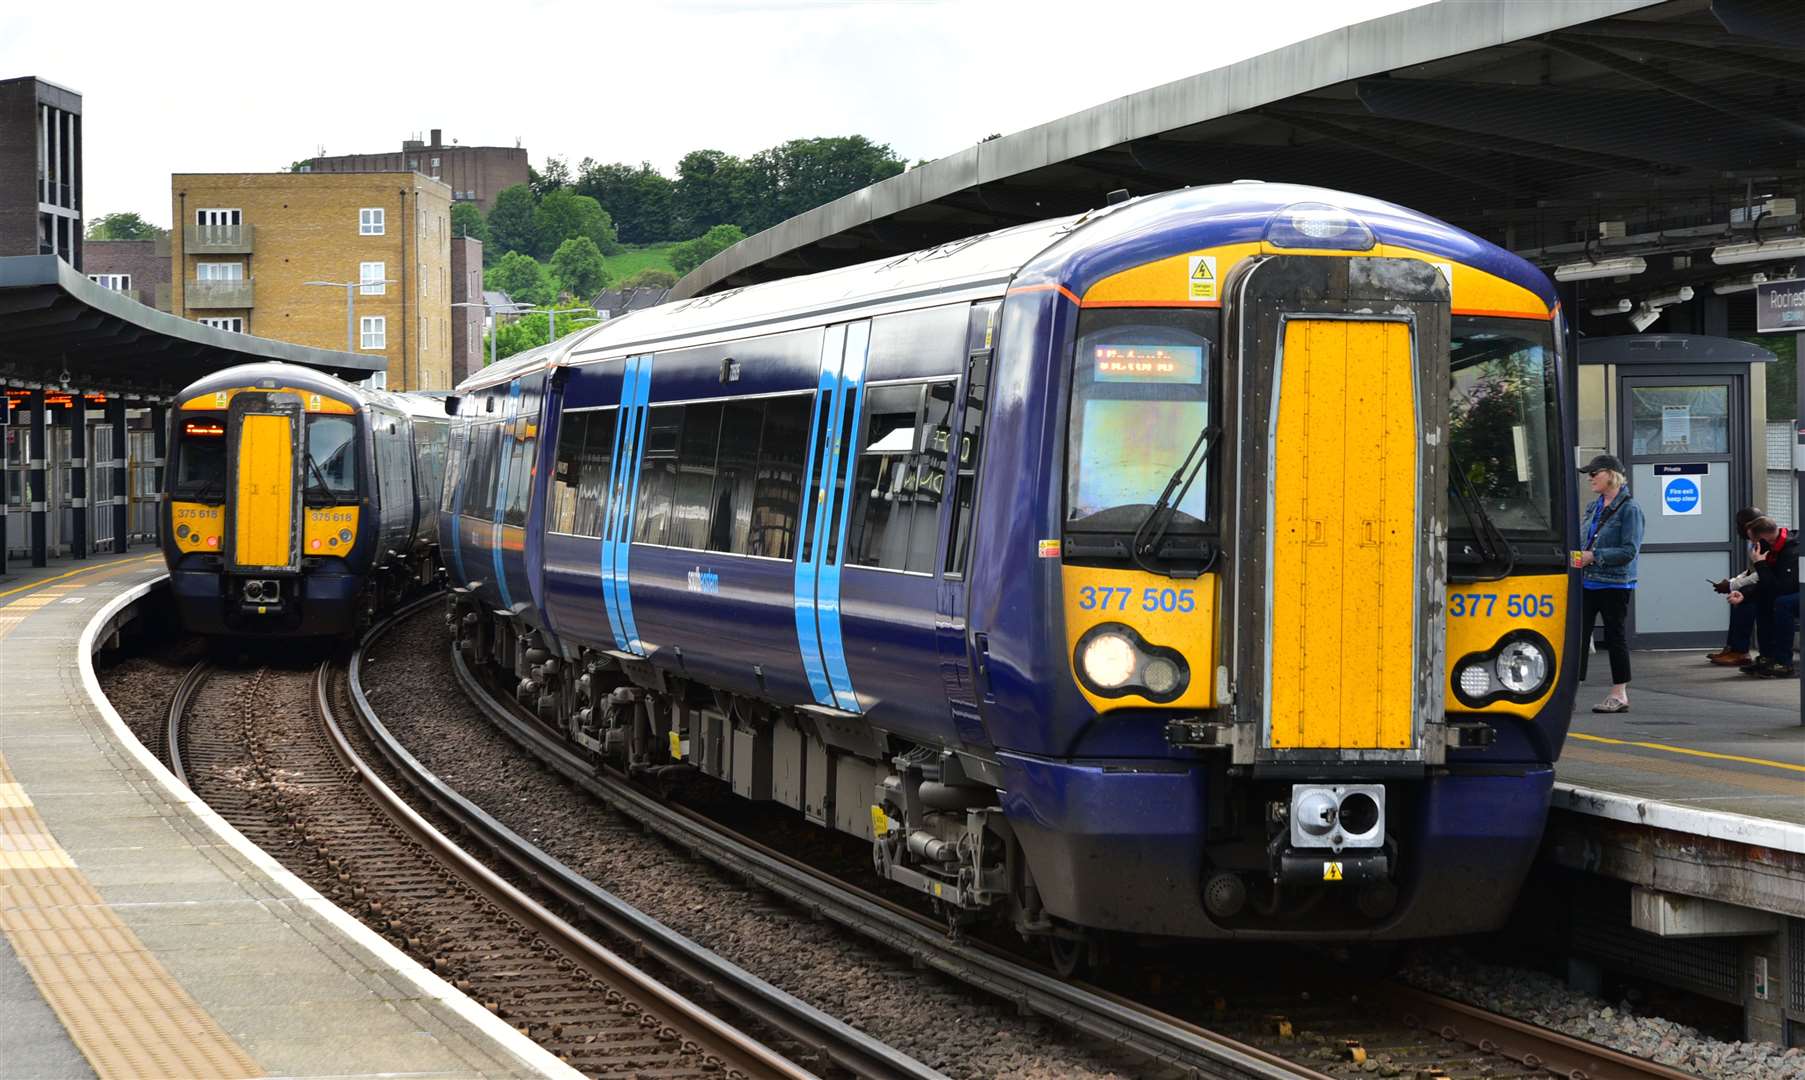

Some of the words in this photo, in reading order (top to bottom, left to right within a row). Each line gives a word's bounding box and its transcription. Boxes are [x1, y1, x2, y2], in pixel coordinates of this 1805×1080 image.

[176, 508, 196, 518] 375
[1079, 586, 1133, 611] 377
[1142, 587, 1196, 613] 505
[1449, 593, 1498, 617] 377
[1506, 594, 1555, 618] 505
